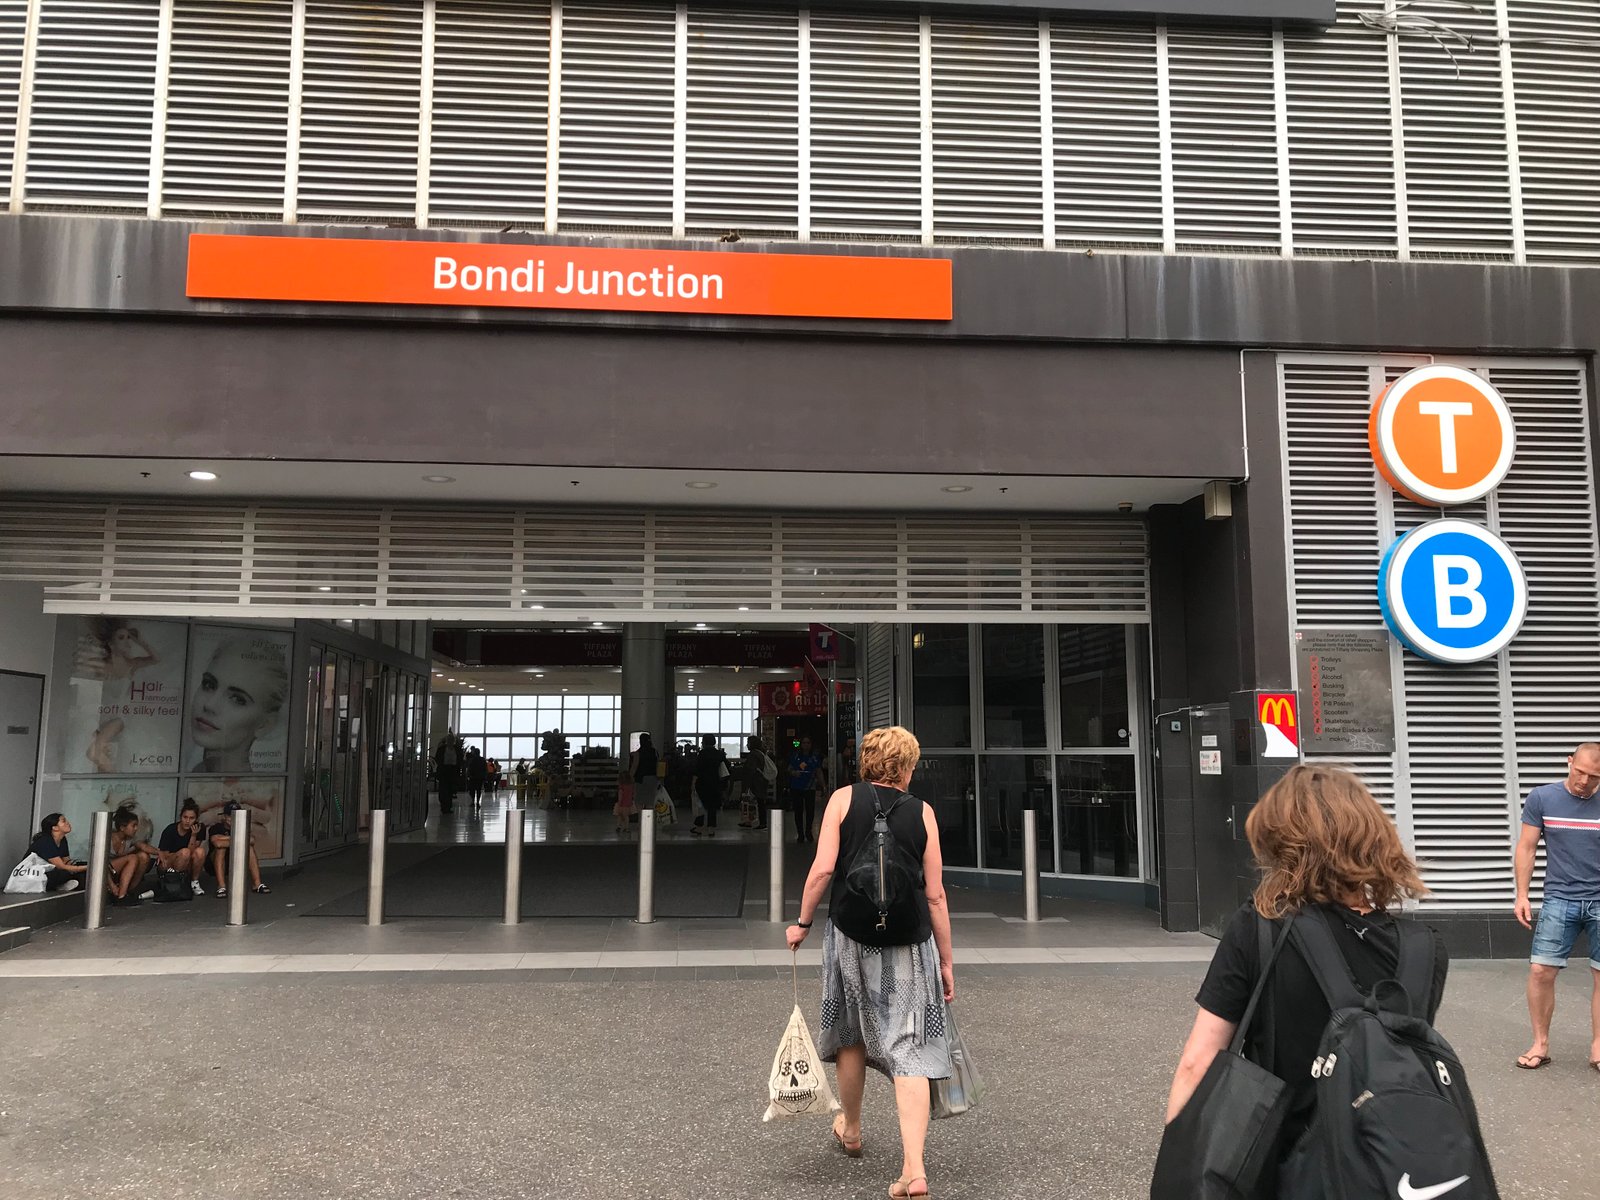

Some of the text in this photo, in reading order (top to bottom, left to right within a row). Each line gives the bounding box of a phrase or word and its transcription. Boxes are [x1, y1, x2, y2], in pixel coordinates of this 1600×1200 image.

[433, 256, 723, 300] Bondi Junction
[1418, 401, 1473, 474] T
[1432, 554, 1488, 629] B
[583, 643, 617, 651] TIFFANY
[744, 644, 777, 652] TIFFANY
[747, 651, 772, 659] PLAZA
[131, 681, 163, 701] Hair
[1322, 682, 1345, 690] Busking
[98, 704, 179, 717] soft & silky feel
